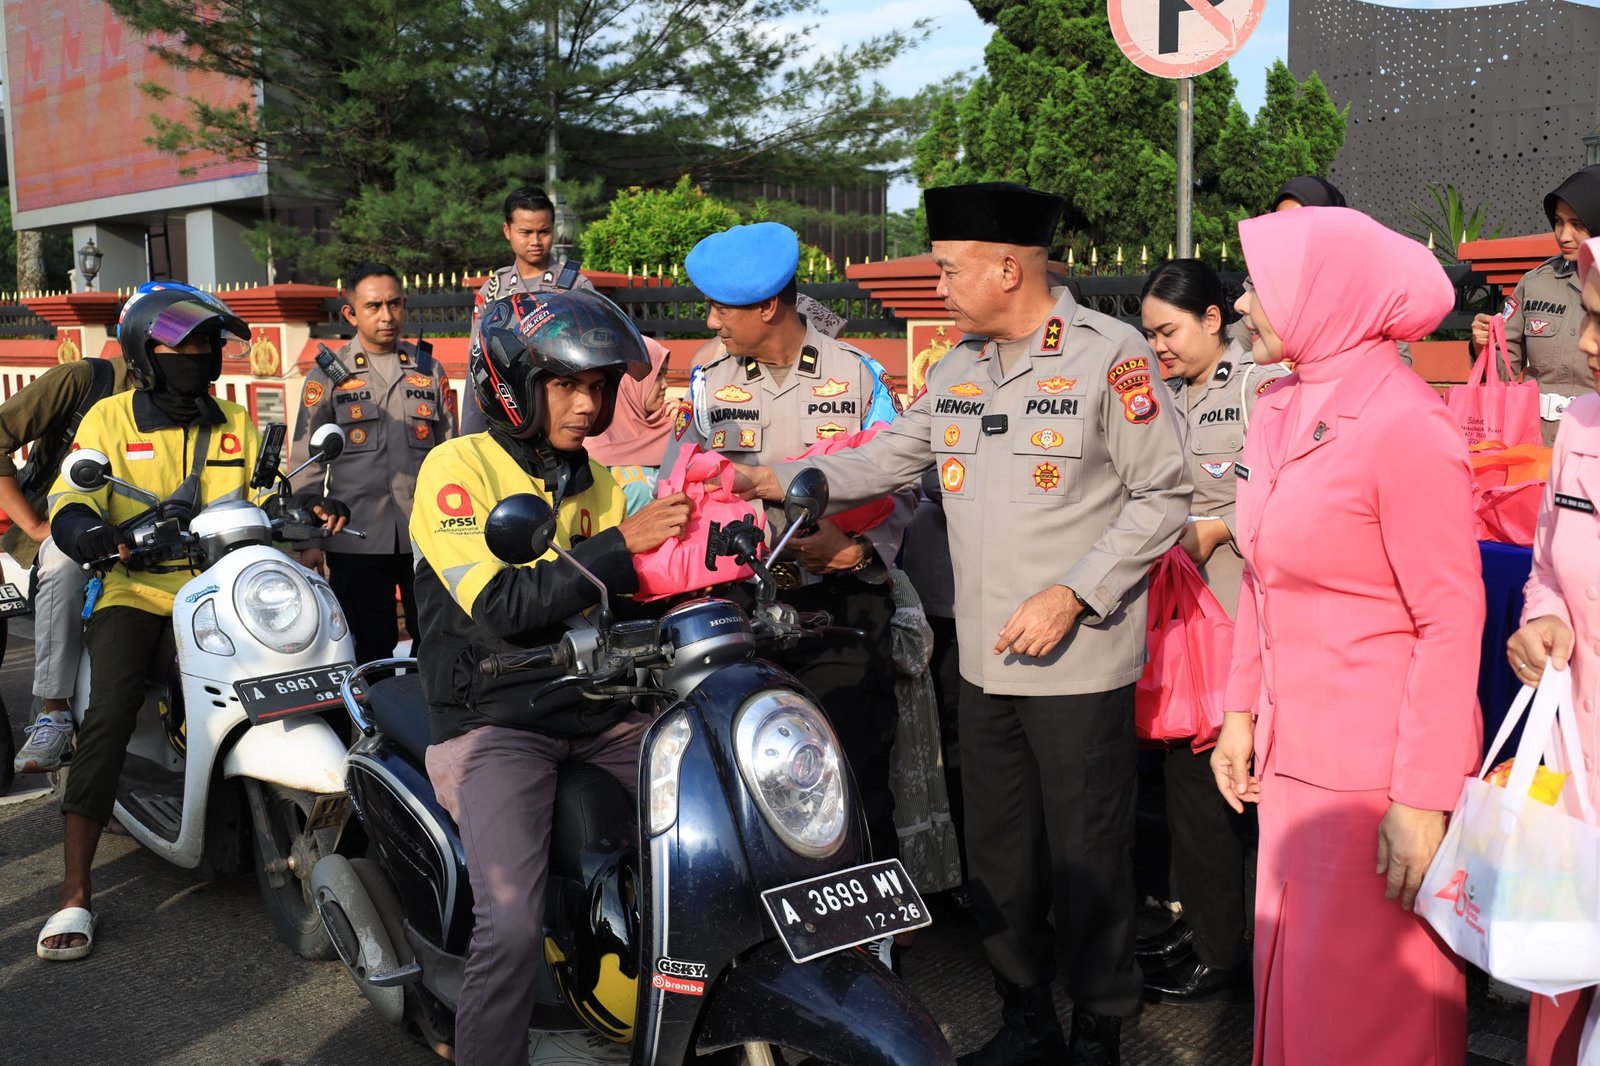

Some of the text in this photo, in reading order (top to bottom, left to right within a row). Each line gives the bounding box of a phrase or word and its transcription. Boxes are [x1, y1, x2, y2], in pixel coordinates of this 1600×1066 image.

[1109, 358, 1146, 381] POLDA
[1117, 375, 1147, 390] BANTEN
[406, 389, 435, 401] POLRI
[808, 400, 856, 415] POLRI
[935, 399, 985, 416] HENGKI
[1026, 398, 1078, 415] POLRI
[1199, 407, 1240, 425] POLRI
[440, 517, 477, 528] YPSSI
[709, 616, 744, 627] HONDA
[253, 687, 266, 700] A
[275, 676, 319, 694] 6961
[782, 898, 801, 925] A
[808, 879, 869, 915] 3699
